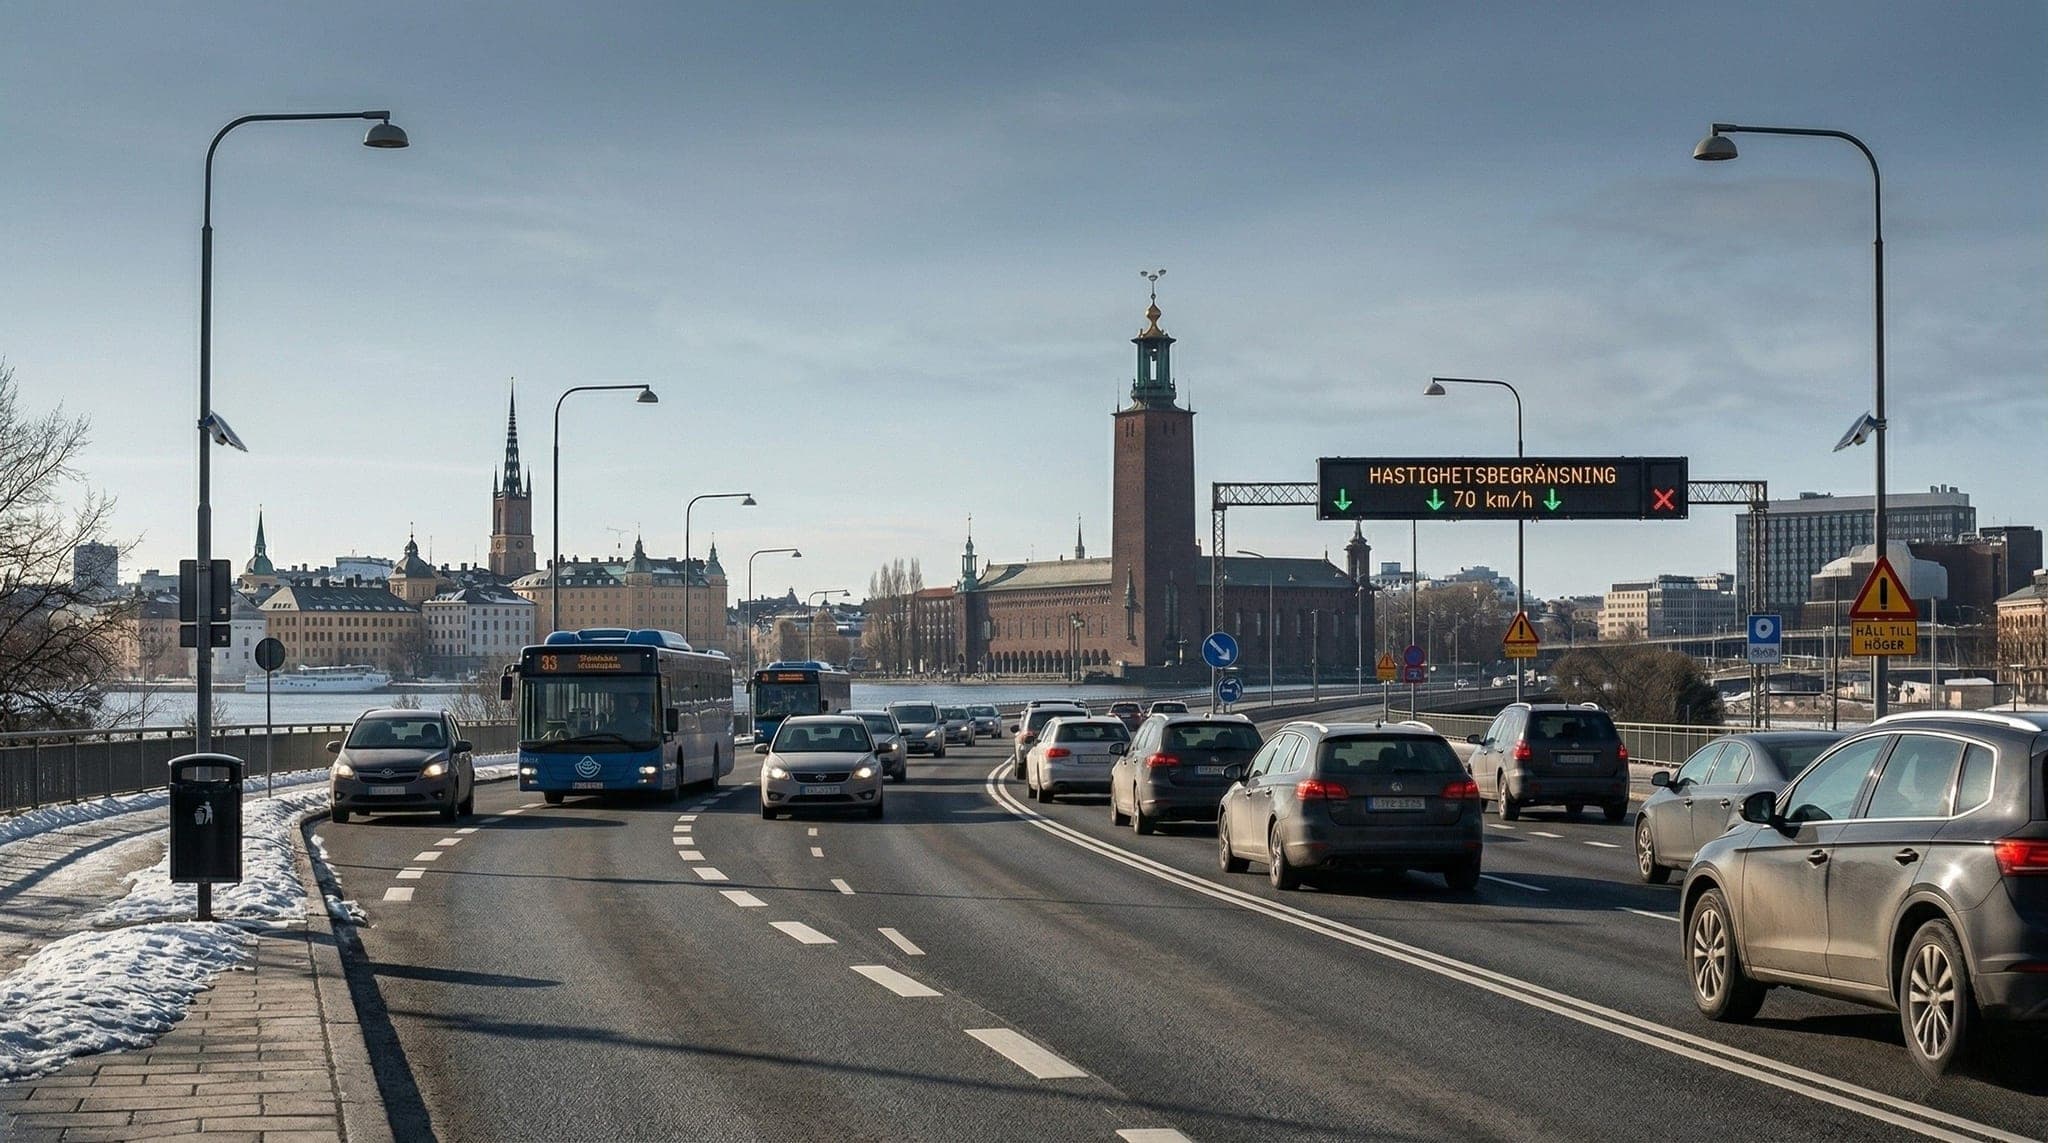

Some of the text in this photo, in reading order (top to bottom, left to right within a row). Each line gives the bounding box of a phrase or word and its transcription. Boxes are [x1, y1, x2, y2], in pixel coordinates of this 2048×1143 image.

[1369, 463, 1617, 485] HASTIGHETSBEGRÄNSNING
[1453, 490, 1533, 508] 70 km/h
[1889, 626, 1912, 637] TILL
[1864, 637, 1905, 650] HÖGER
